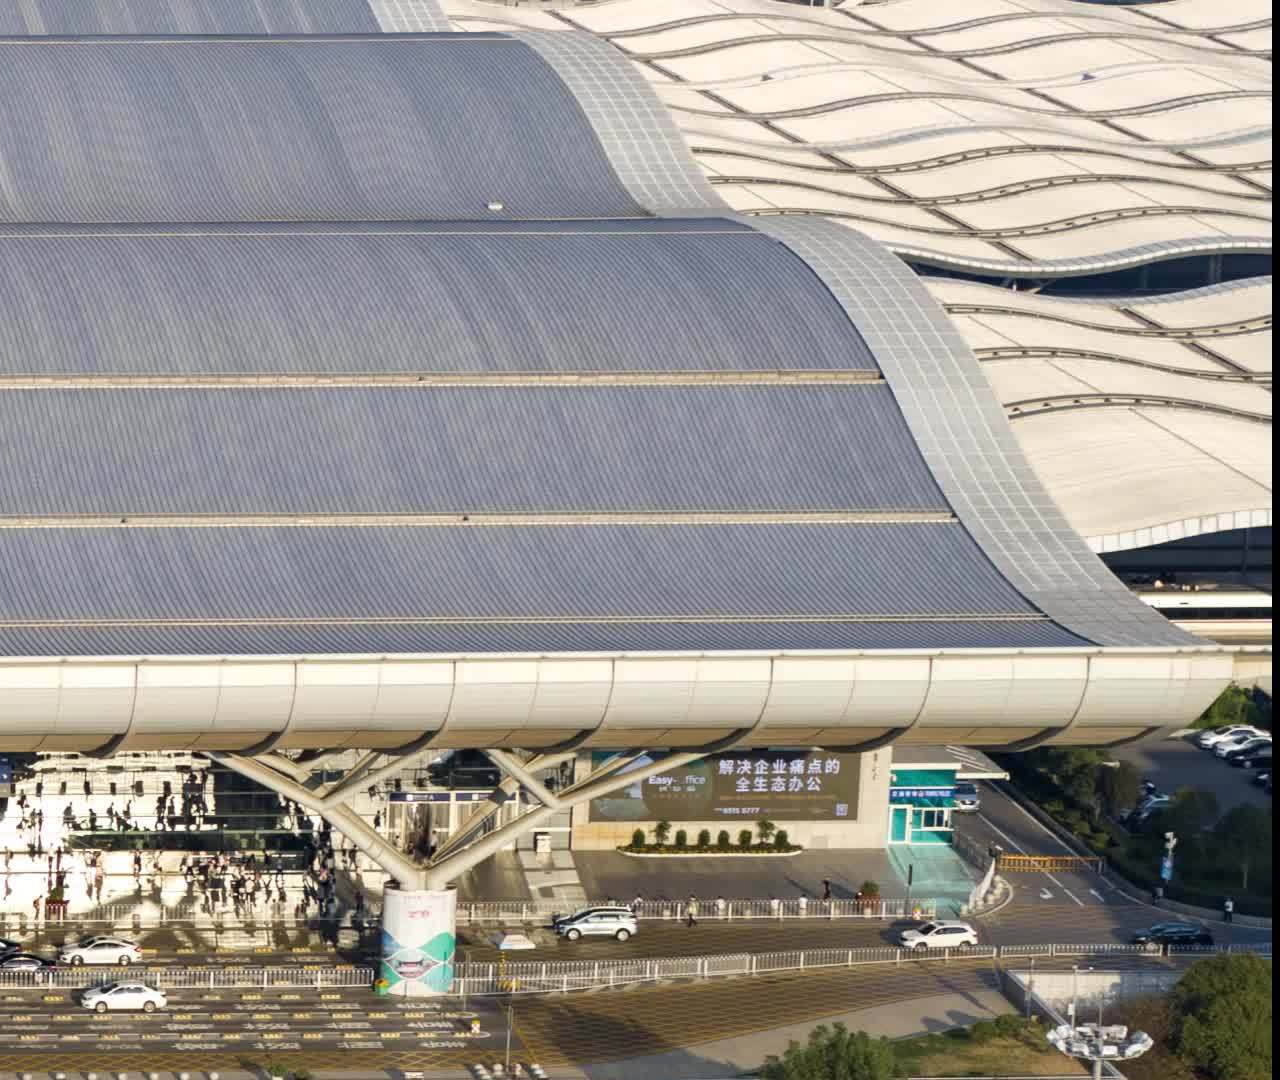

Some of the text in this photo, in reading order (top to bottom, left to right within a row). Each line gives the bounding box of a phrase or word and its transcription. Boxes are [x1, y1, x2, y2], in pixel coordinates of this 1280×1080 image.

[718, 758, 841, 775] 解决企业痛点的
[735, 776, 822, 793] 全生态办公
